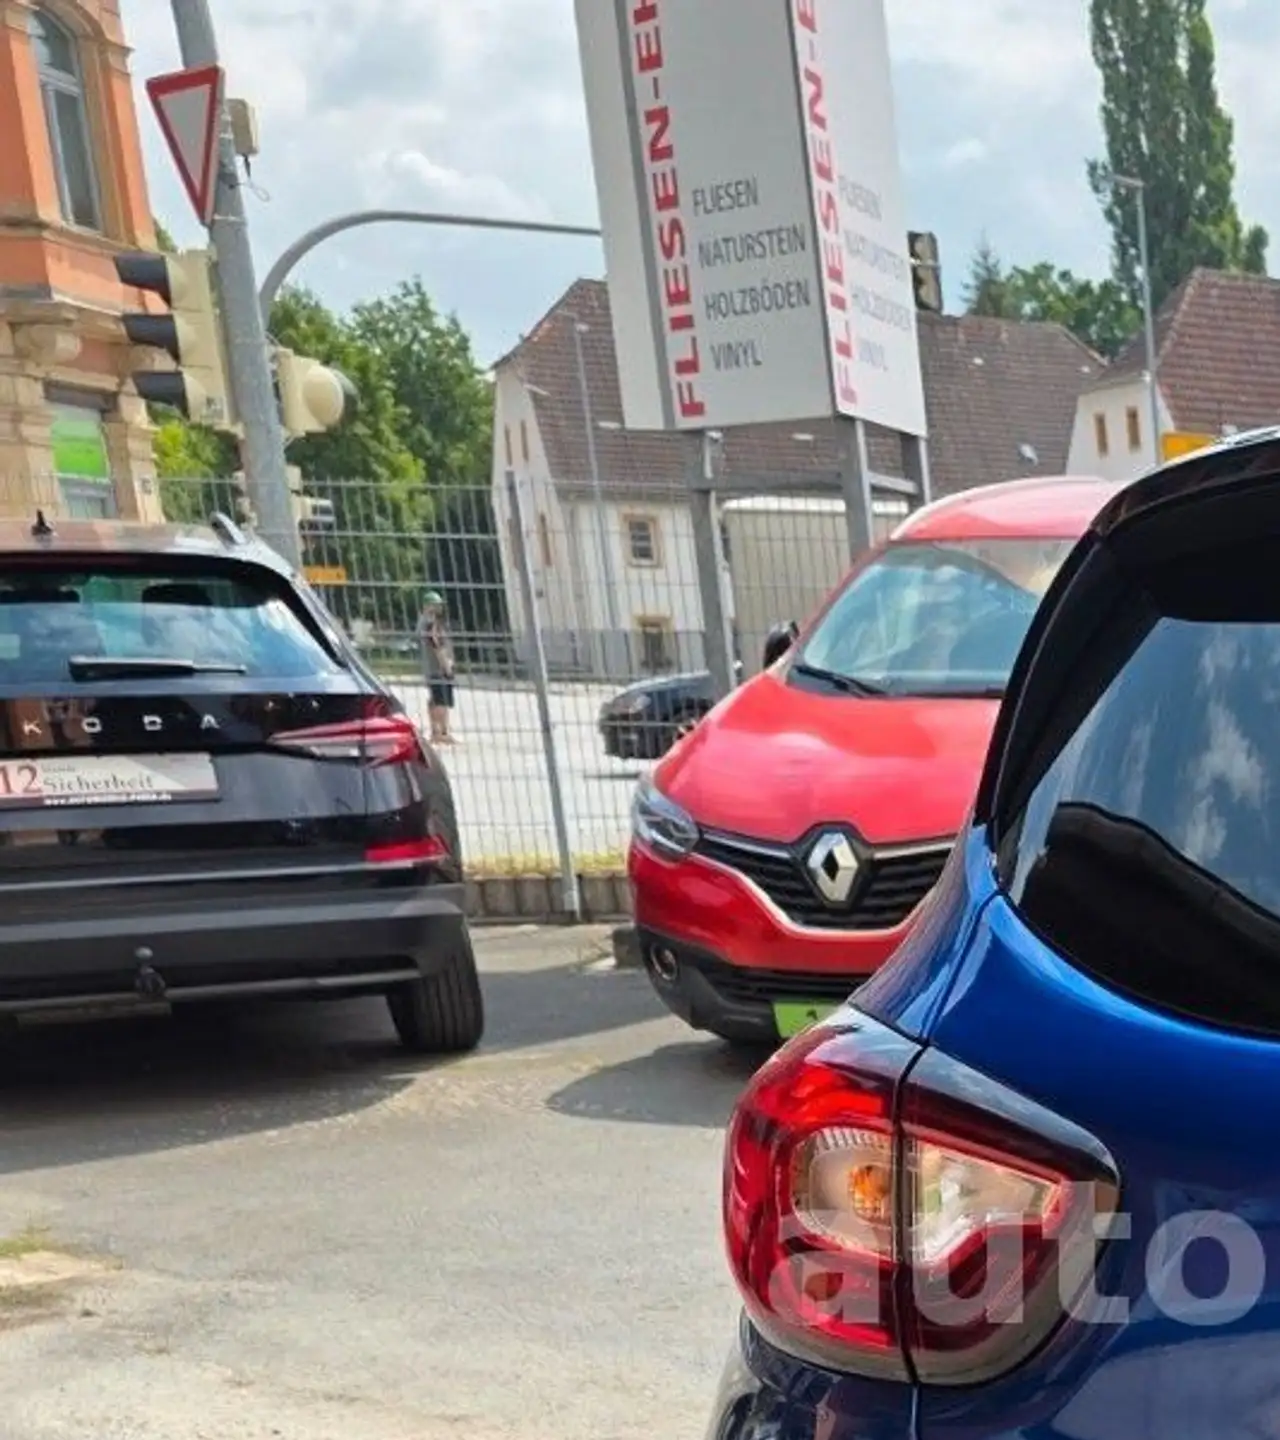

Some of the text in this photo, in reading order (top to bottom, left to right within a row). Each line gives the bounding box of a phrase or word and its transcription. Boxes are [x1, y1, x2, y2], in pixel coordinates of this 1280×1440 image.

[692, 176, 760, 217] FLIESEN
[698, 222, 807, 269] NATURSTEIN
[704, 276, 811, 321] HOLZBÖDEN
[710, 338, 763, 371] VINYL
